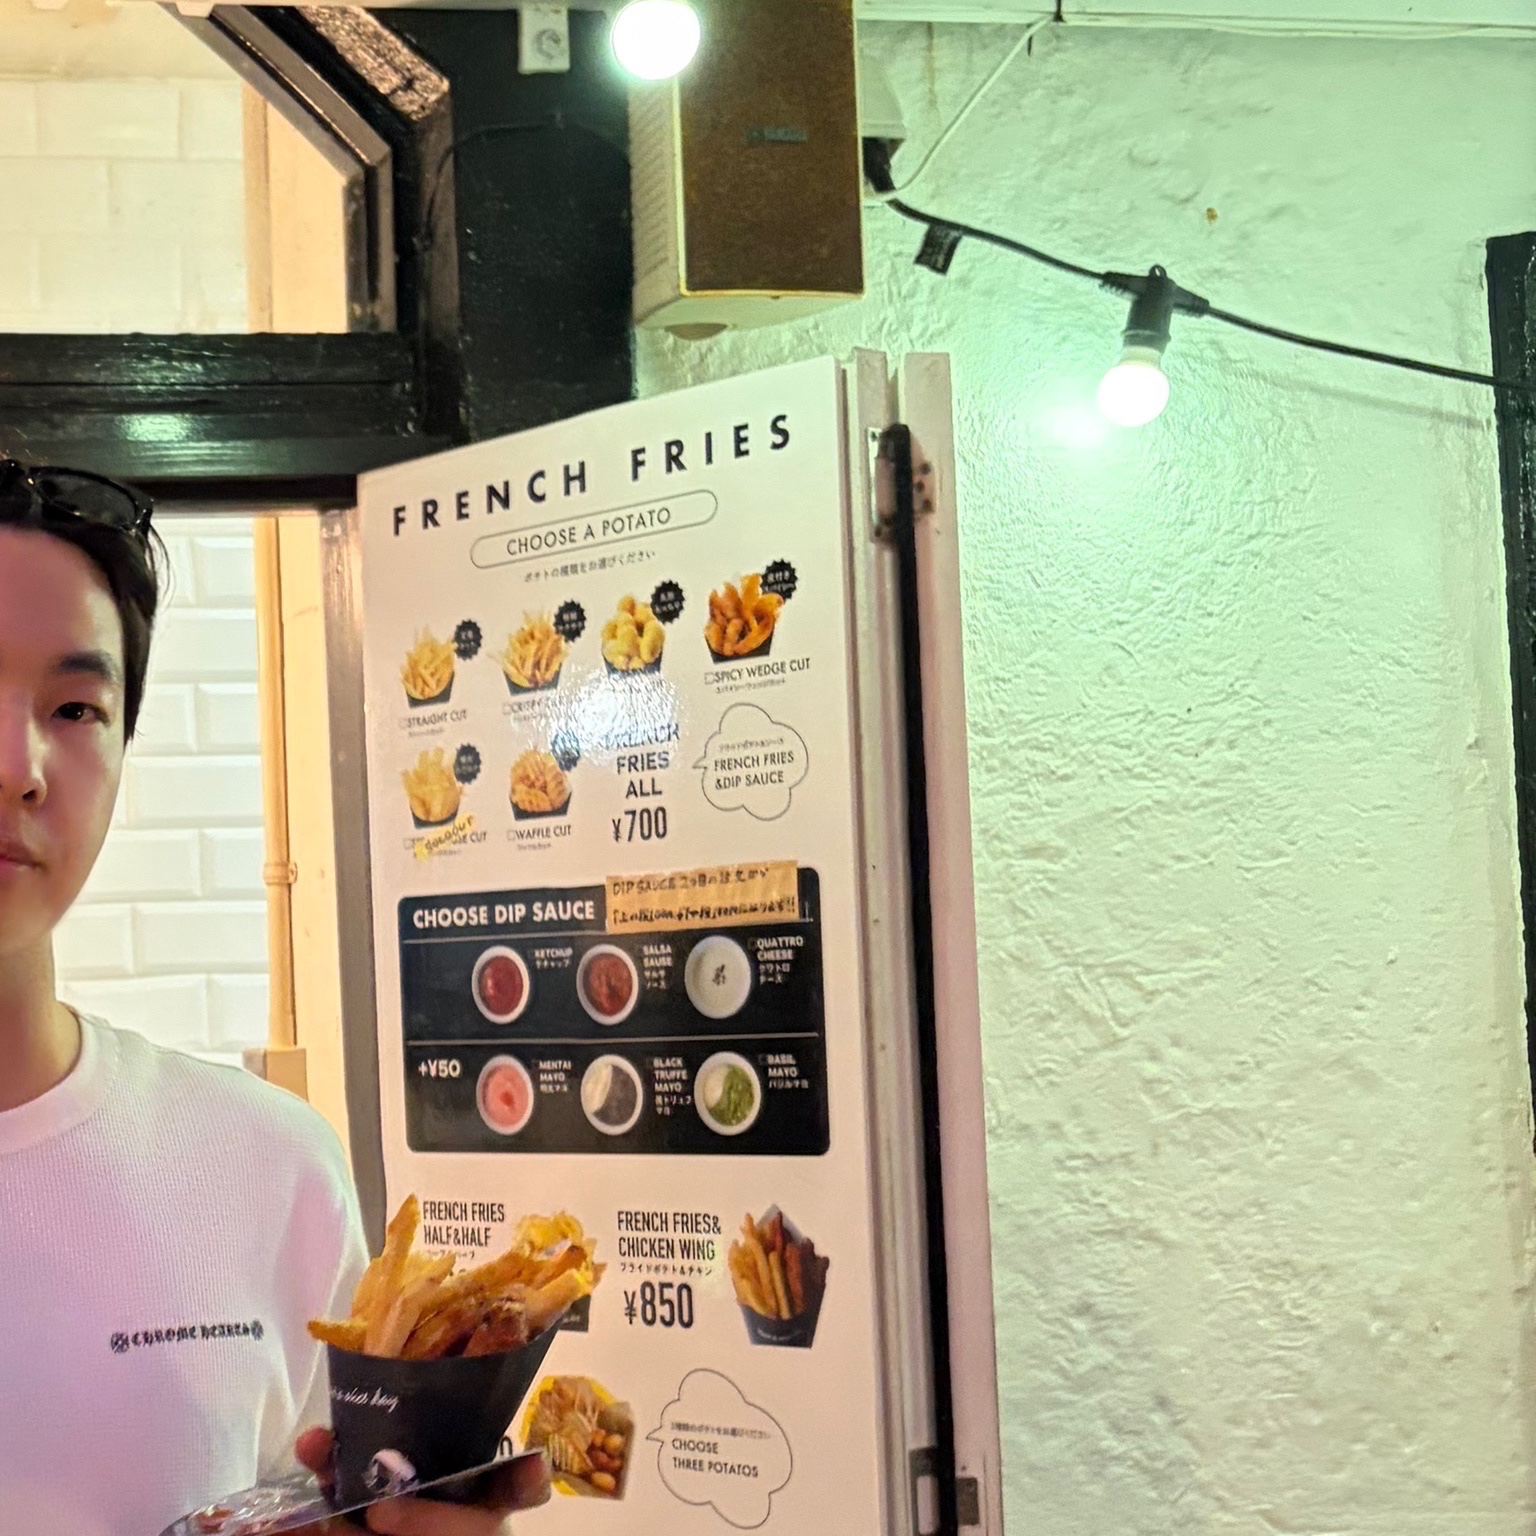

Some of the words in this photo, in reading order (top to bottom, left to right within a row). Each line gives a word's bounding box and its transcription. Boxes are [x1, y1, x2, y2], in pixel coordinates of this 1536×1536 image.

[392, 460, 587, 537] FRENCH
[630, 414, 792, 482] FRIES
[506, 528, 578, 557] CHOOSE
[583, 523, 596, 541] A
[601, 506, 672, 538] POTATO
[714, 668, 744, 684] SPICY
[746, 661, 787, 678] WEDGE
[790, 657, 811, 672] CUT
[406, 711, 449, 730] STRAIGHT
[450, 709, 468, 722] CUT
[616, 750, 670, 775] FRIES
[714, 754, 761, 772] FRENCH
[763, 750, 795, 766] FRIES
[625, 776, 663, 799] ALL
[715, 776, 742, 790] &DIP
[745, 770, 785, 787] SAUCE
[515, 828, 551, 841] WAFFLE
[553, 824, 572, 836] CUT
[612, 806, 668, 842] ¥700
[469, 831, 487, 844] CUT
[412, 903, 489, 929] CHOOSE
[493, 905, 526, 924] DIP
[532, 900, 595, 922] SAUCE
[642, 944, 672, 956] SALSA
[757, 935, 804, 949] QUATTRO
[534, 947, 573, 959] KETCHUP
[757, 949, 794, 961] CHEESE
[417, 1058, 461, 1079] +¥50
[539, 1060, 571, 1070] MENTAI
[653, 1057, 683, 1068] BLACK
[766, 1053, 797, 1065] BASIL
[539, 1072, 566, 1082] MAYO
[768, 1066, 798, 1078] MAYO
[654, 1082, 682, 1093] MAYO
[422, 1200, 468, 1223] FRENCH
[470, 1203, 505, 1224] FRIES
[617, 1210, 669, 1234] FRENCH
[672, 1212, 722, 1235] FRIES&
[423, 1225, 492, 1249] HALF&HALF
[618, 1237, 676, 1260] CHICKEN
[679, 1238, 716, 1261] WING
[623, 1281, 694, 1329] ¥850
[671, 1438, 719, 1455] CHOOSE
[672, 1456, 705, 1472] THREE
